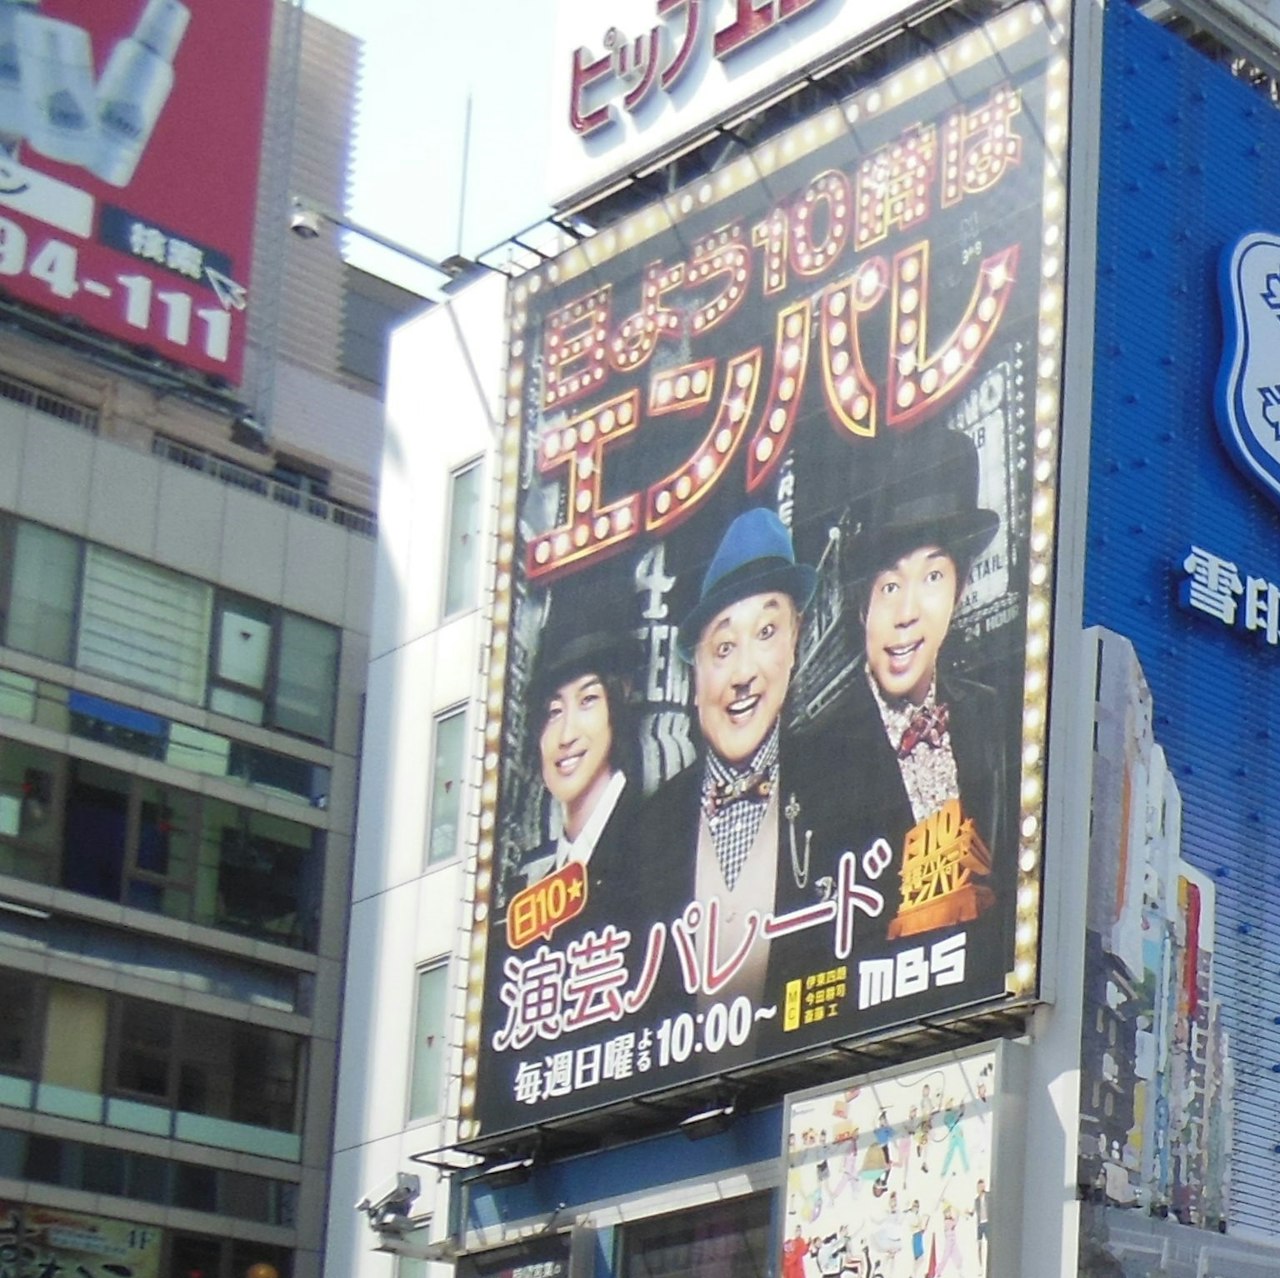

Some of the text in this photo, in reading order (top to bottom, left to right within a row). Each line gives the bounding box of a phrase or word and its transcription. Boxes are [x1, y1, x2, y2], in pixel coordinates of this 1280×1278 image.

[524, 240, 1024, 580] エンパレ
[492, 837, 893, 1051] 演芸パレード
[513, 878, 566, 939] 日10
